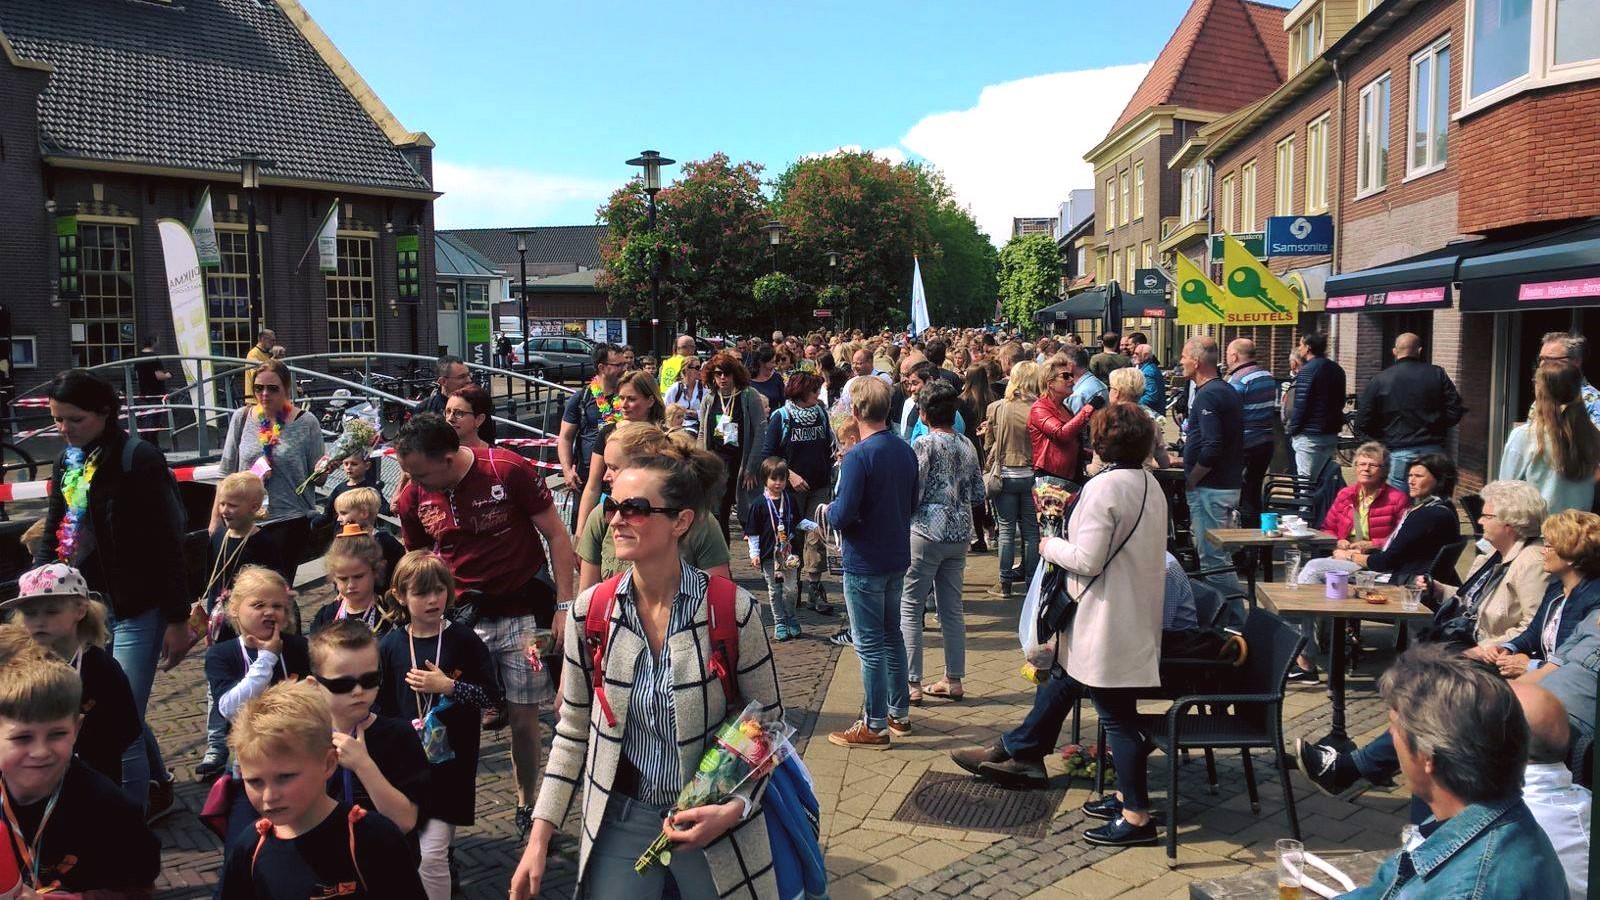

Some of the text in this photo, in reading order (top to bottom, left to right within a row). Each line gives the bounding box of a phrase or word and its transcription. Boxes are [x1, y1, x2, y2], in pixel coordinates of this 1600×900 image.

[1272, 243, 1328, 253] Samsonite
[1227, 312, 1293, 322] SLEUTELS
[790, 426, 825, 442] NAVY
